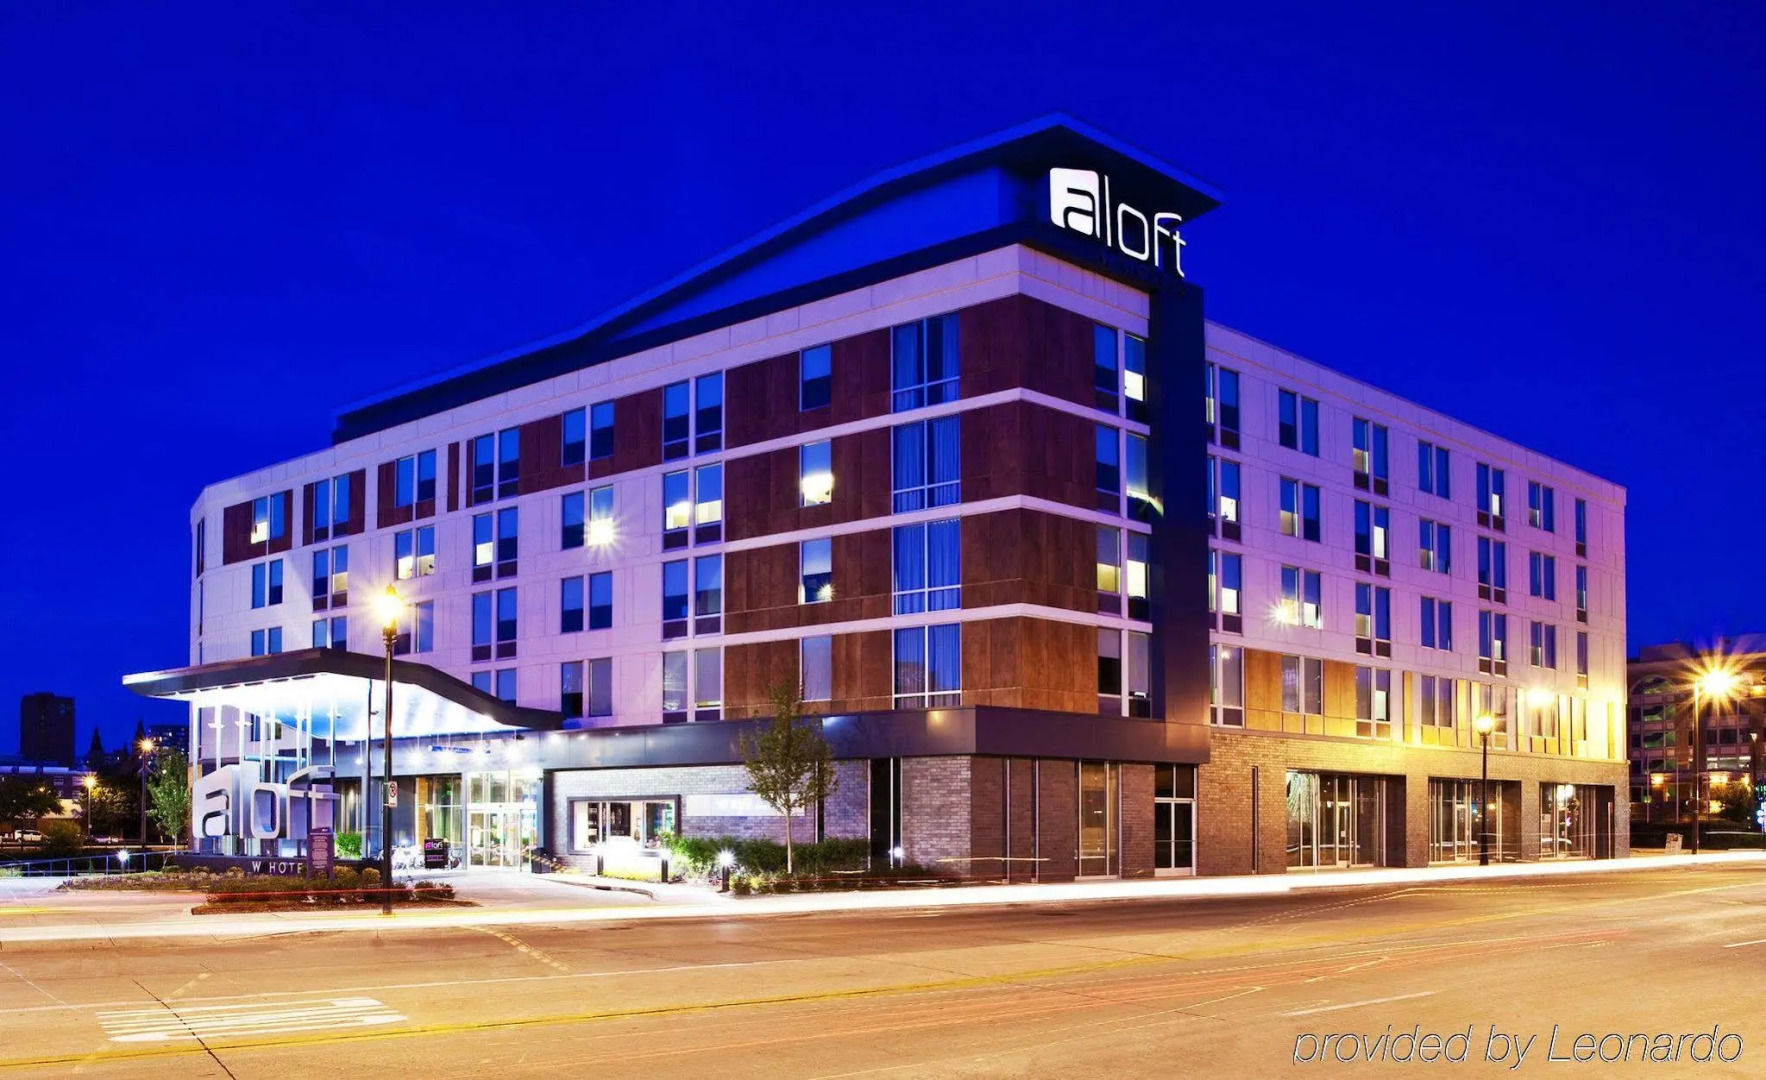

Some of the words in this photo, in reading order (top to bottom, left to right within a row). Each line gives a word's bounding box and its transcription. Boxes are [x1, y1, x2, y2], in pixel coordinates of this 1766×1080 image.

[1050, 167, 1187, 277] aloft
[192, 761, 341, 840] aloft
[251, 860, 262, 873] W
[269, 861, 304, 875] HOTE
